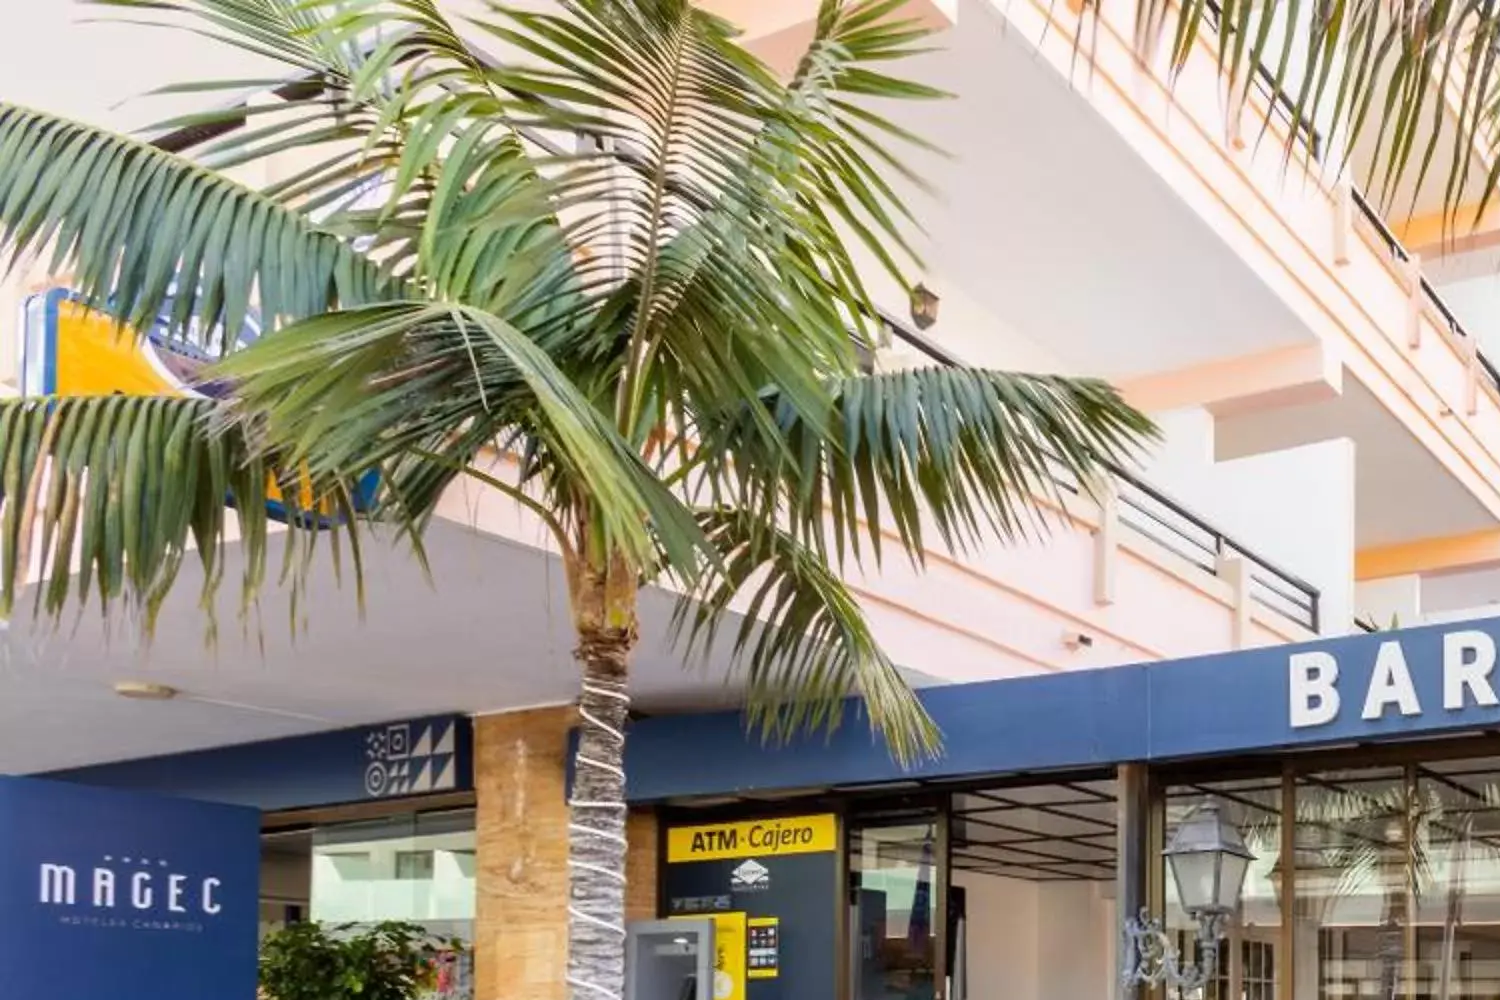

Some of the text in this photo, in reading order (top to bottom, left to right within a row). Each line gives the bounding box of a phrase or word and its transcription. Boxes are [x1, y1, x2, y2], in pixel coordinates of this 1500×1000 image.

[1290, 630, 1499, 727] BAR
[691, 829, 737, 852] ATM
[748, 824, 813, 850] Cajero
[40, 863, 221, 914] MAGEC
